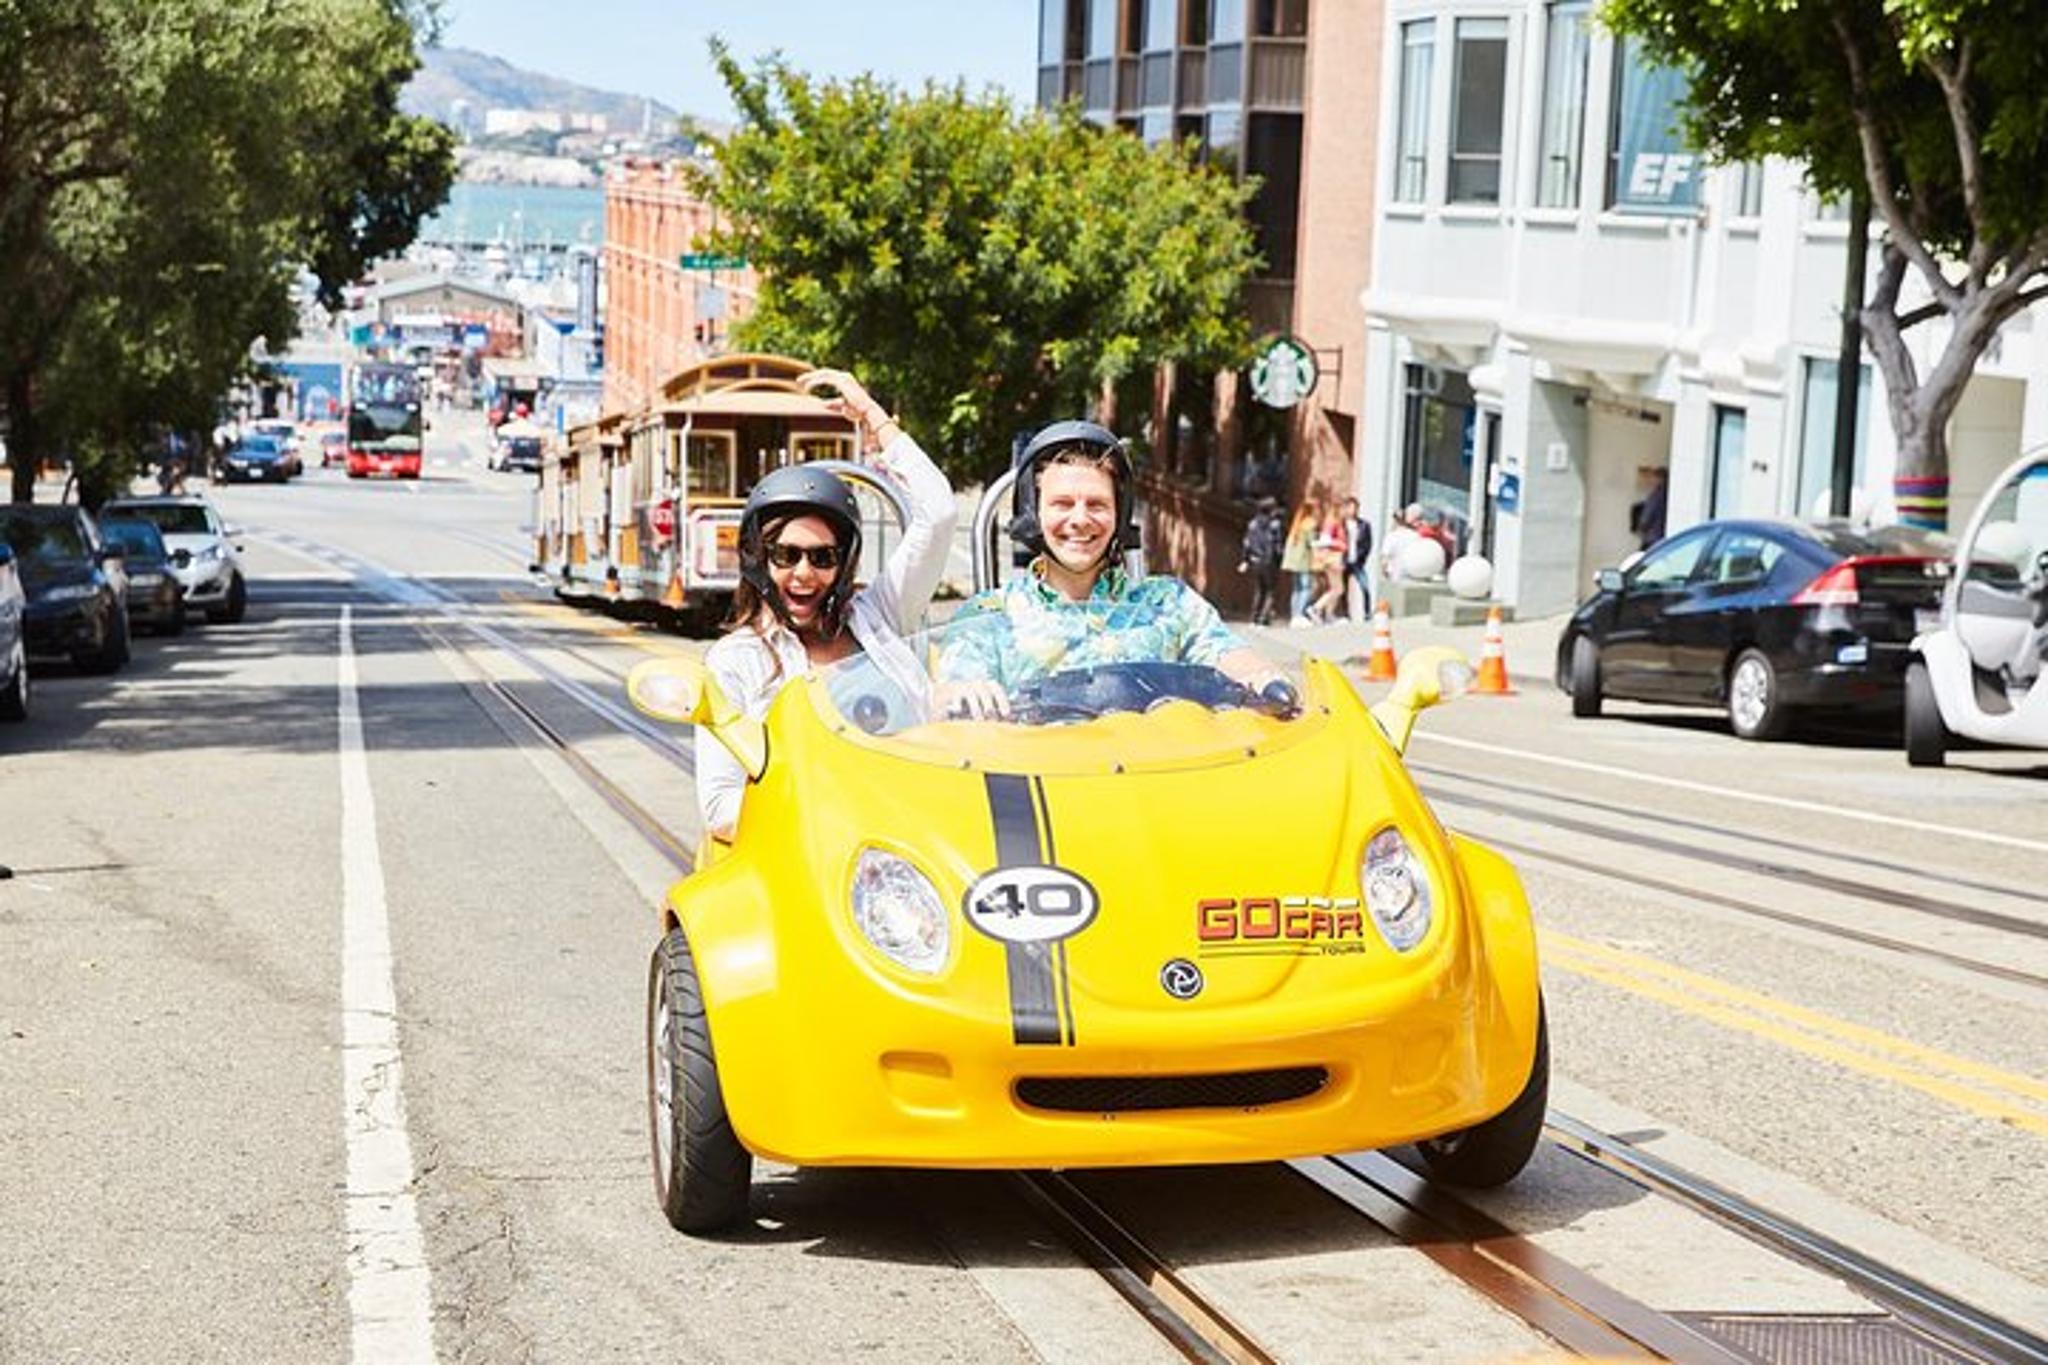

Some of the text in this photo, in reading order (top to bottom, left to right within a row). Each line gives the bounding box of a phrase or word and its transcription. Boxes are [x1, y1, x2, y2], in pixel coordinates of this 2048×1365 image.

[1629, 152, 1694, 198] EF
[975, 883, 1082, 918] 40
[1319, 945, 1366, 956] TOURS
